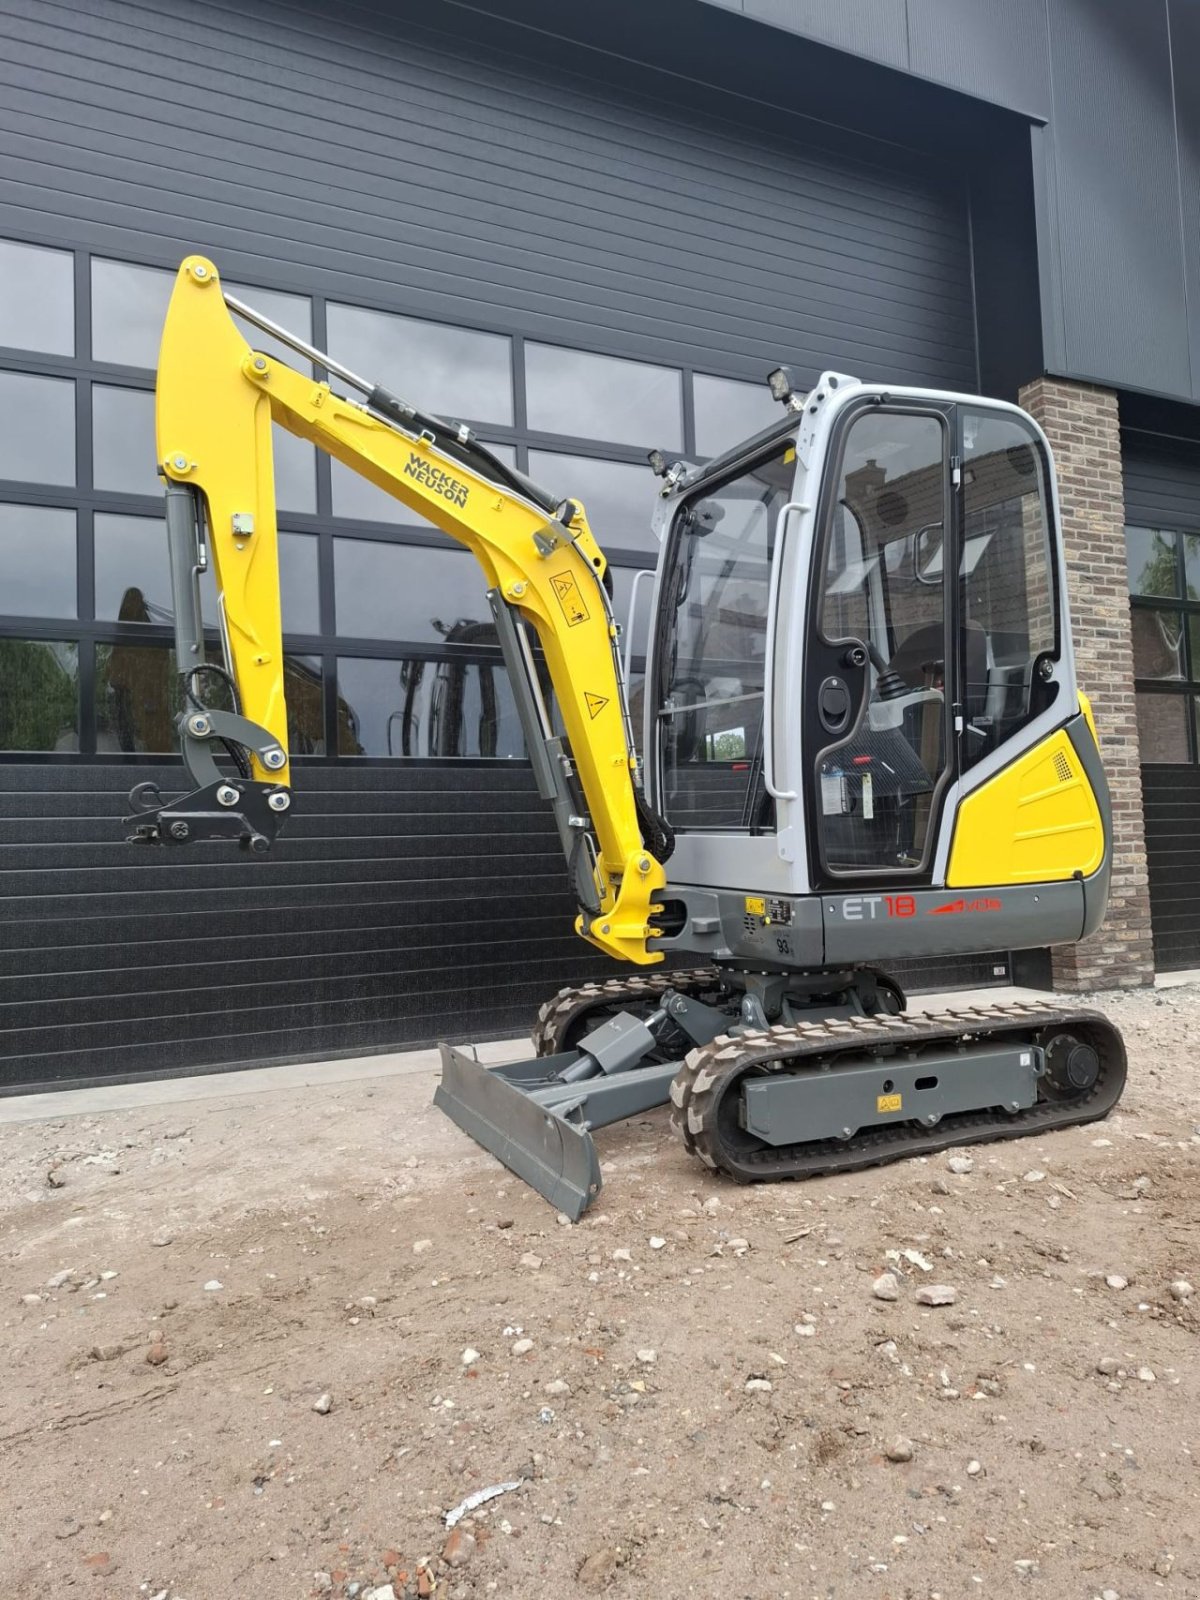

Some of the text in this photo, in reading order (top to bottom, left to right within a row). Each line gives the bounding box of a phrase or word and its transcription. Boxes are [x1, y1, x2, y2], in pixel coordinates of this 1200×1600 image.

[403, 463, 467, 508] NEUSON
[409, 452, 469, 498] WACKER
[842, 895, 917, 920] ET18
[776, 938, 790, 954] 93
